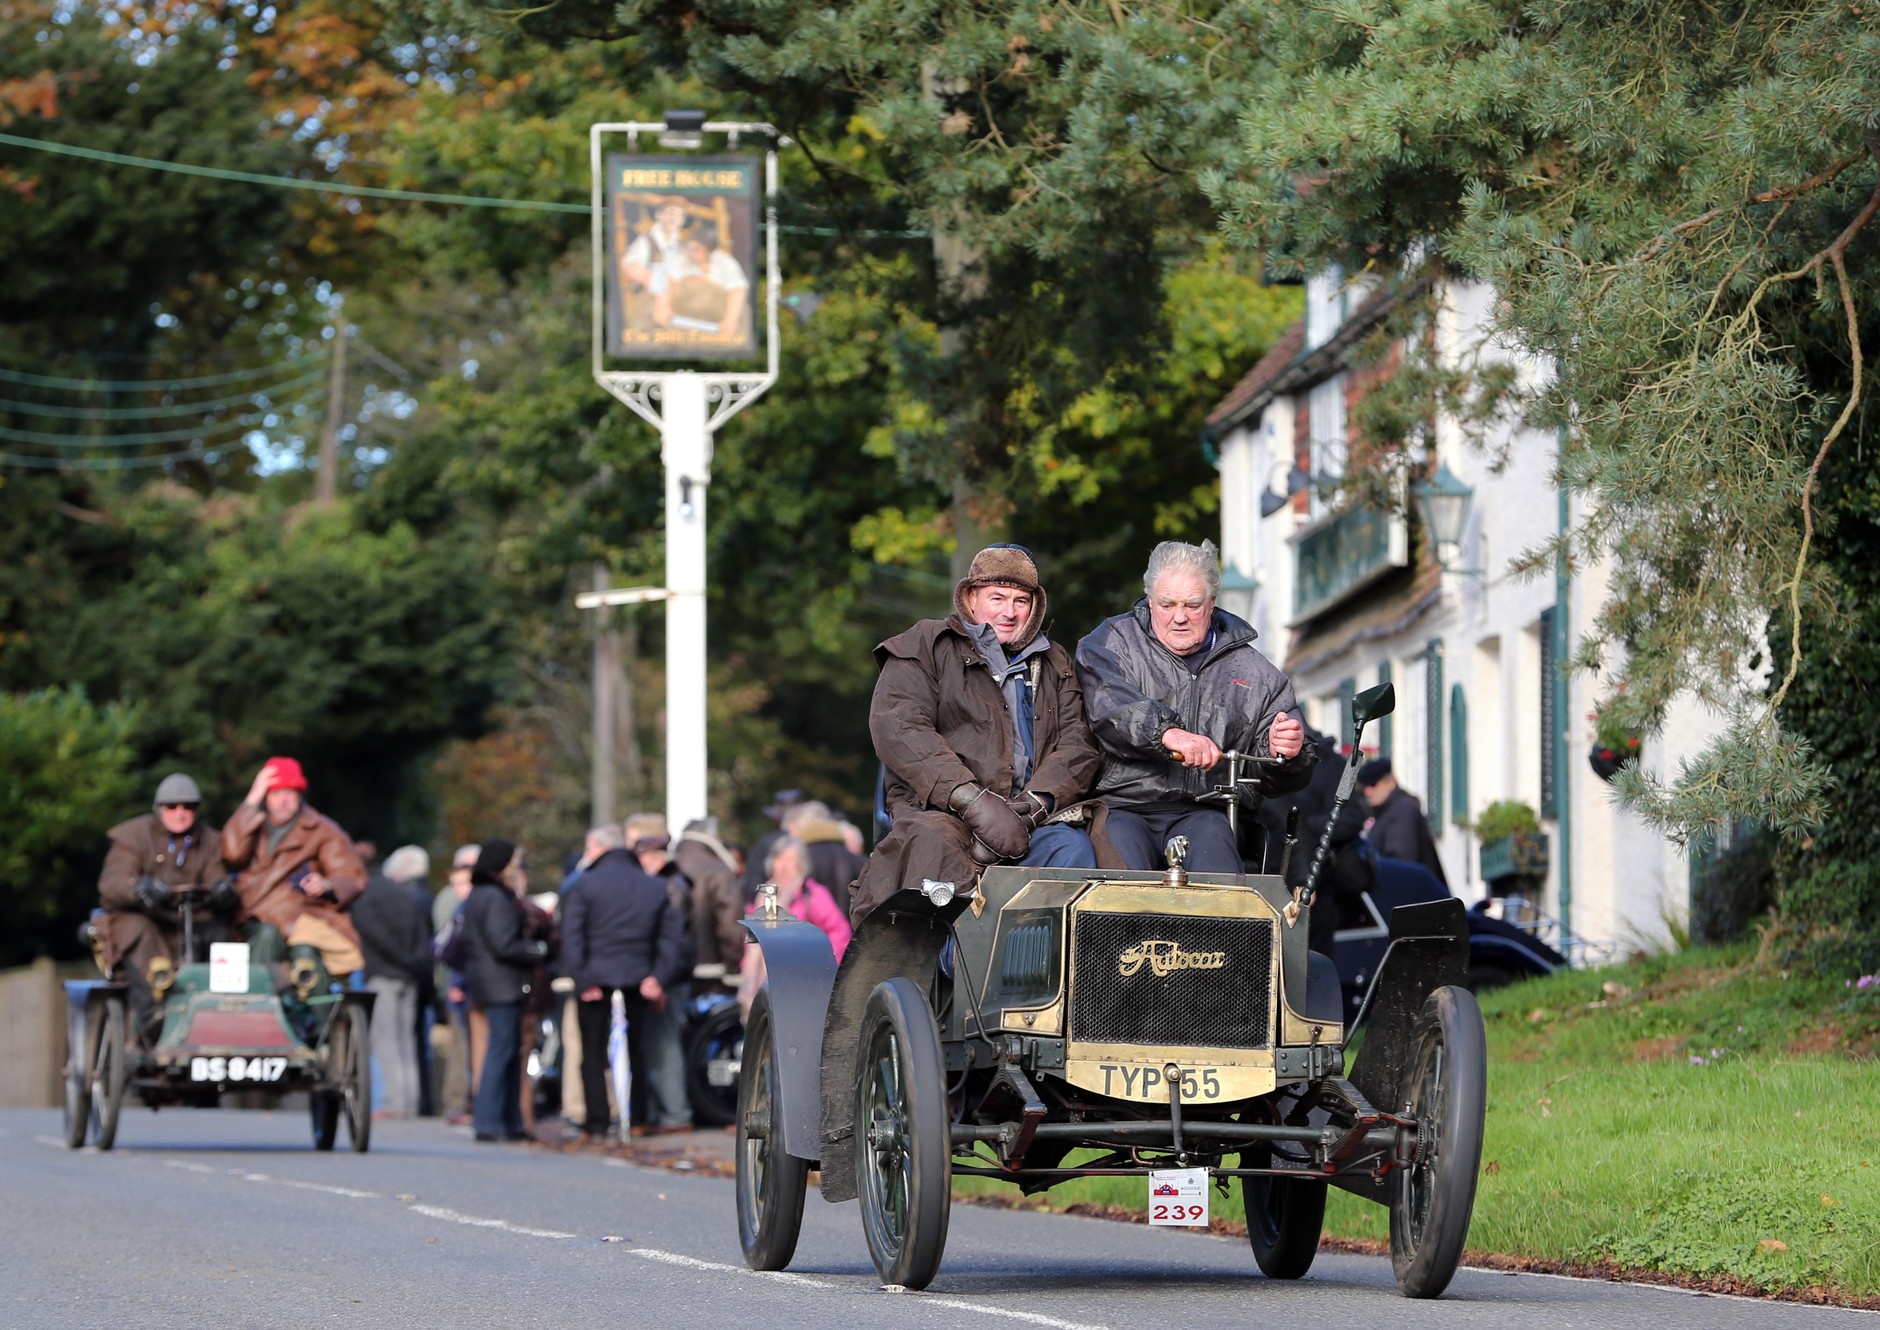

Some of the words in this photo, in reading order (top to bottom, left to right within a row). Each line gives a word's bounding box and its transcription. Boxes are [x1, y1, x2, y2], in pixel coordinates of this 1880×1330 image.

[622, 169, 673, 188] FREE
[674, 170, 744, 189] HOUSE
[1119, 940, 1226, 977] Autocar
[1100, 1065, 1161, 1098] TYP
[1181, 1068, 1220, 1099] 55
[1153, 1204, 1204, 1220] 239
